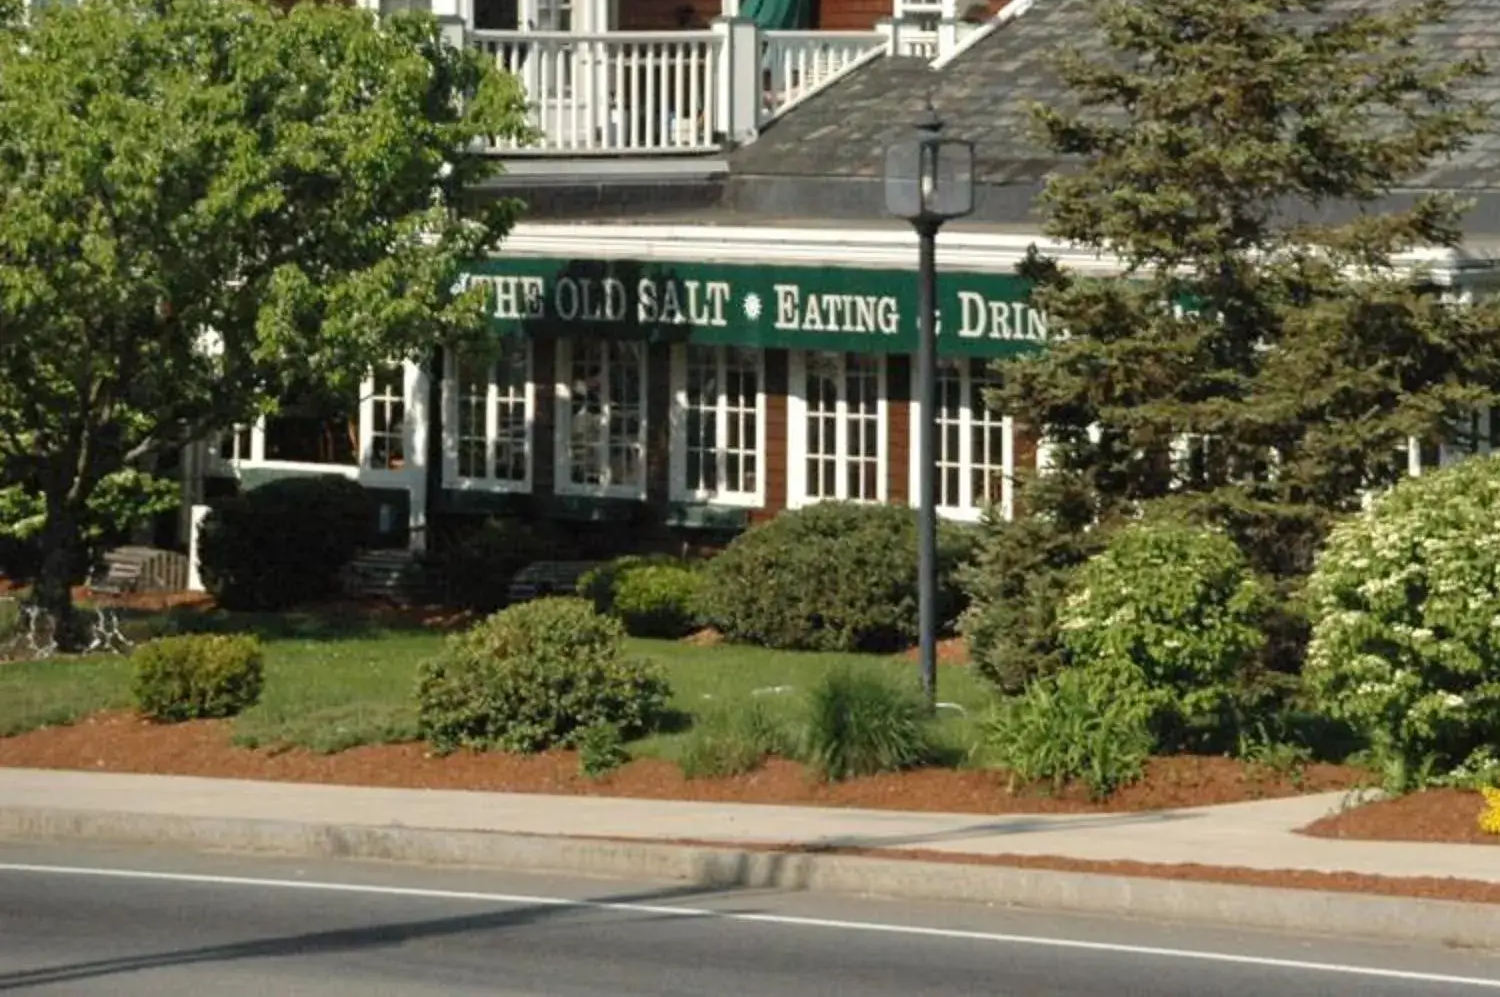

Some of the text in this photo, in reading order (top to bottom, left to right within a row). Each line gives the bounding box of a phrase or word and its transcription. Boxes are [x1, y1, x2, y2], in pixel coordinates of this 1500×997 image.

[555, 276, 627, 322] OLD
[637, 277, 731, 327] SALT
[773, 284, 900, 334] EATING
[957, 290, 1072, 341] DRIN
